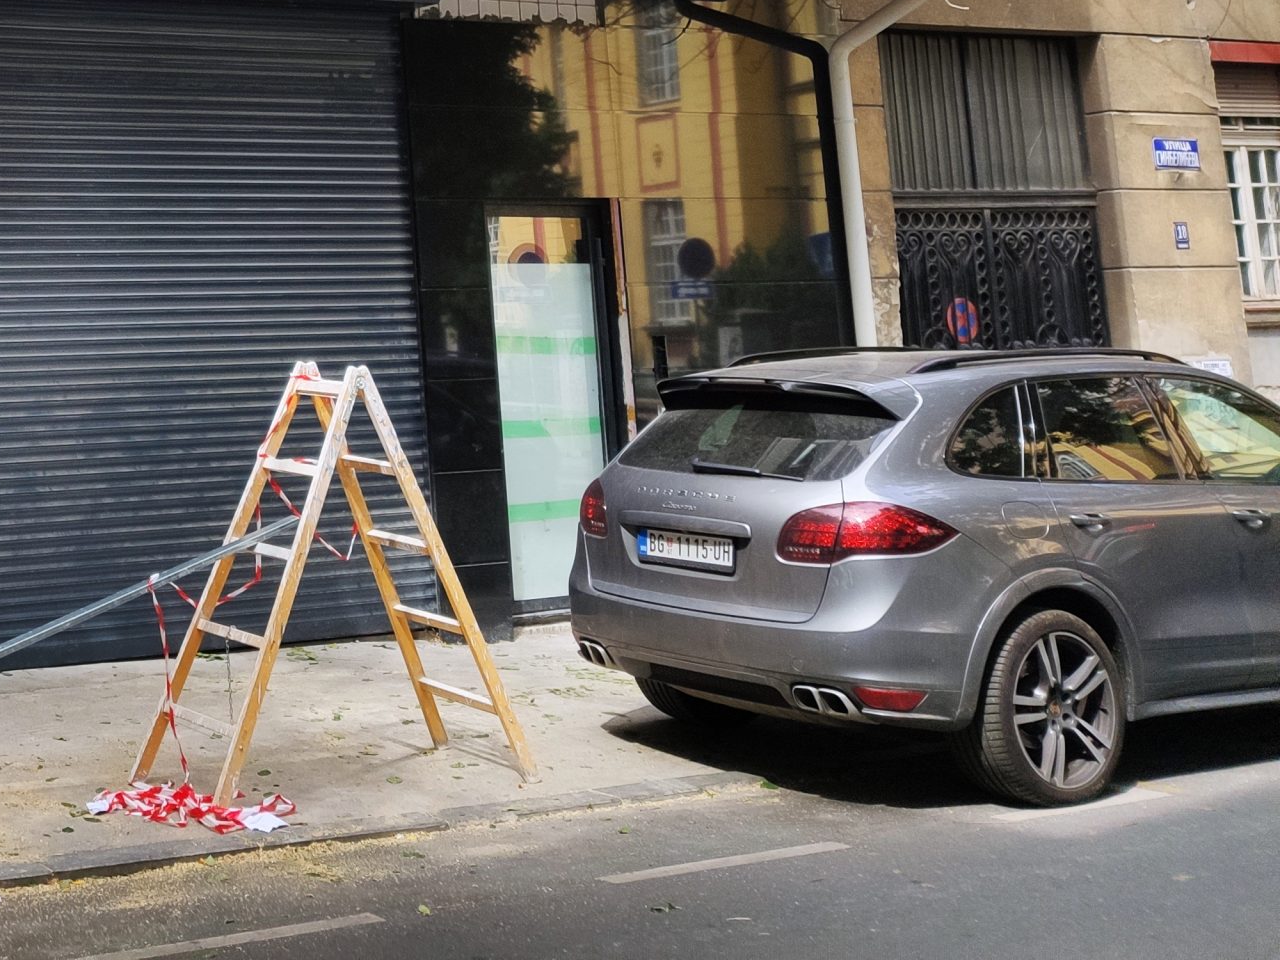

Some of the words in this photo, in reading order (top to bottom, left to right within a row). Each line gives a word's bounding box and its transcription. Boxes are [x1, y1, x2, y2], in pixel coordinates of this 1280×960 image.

[1163, 140, 1192, 151] УЛИЦА
[1176, 224, 1188, 239] 18
[649, 532, 665, 553] BG
